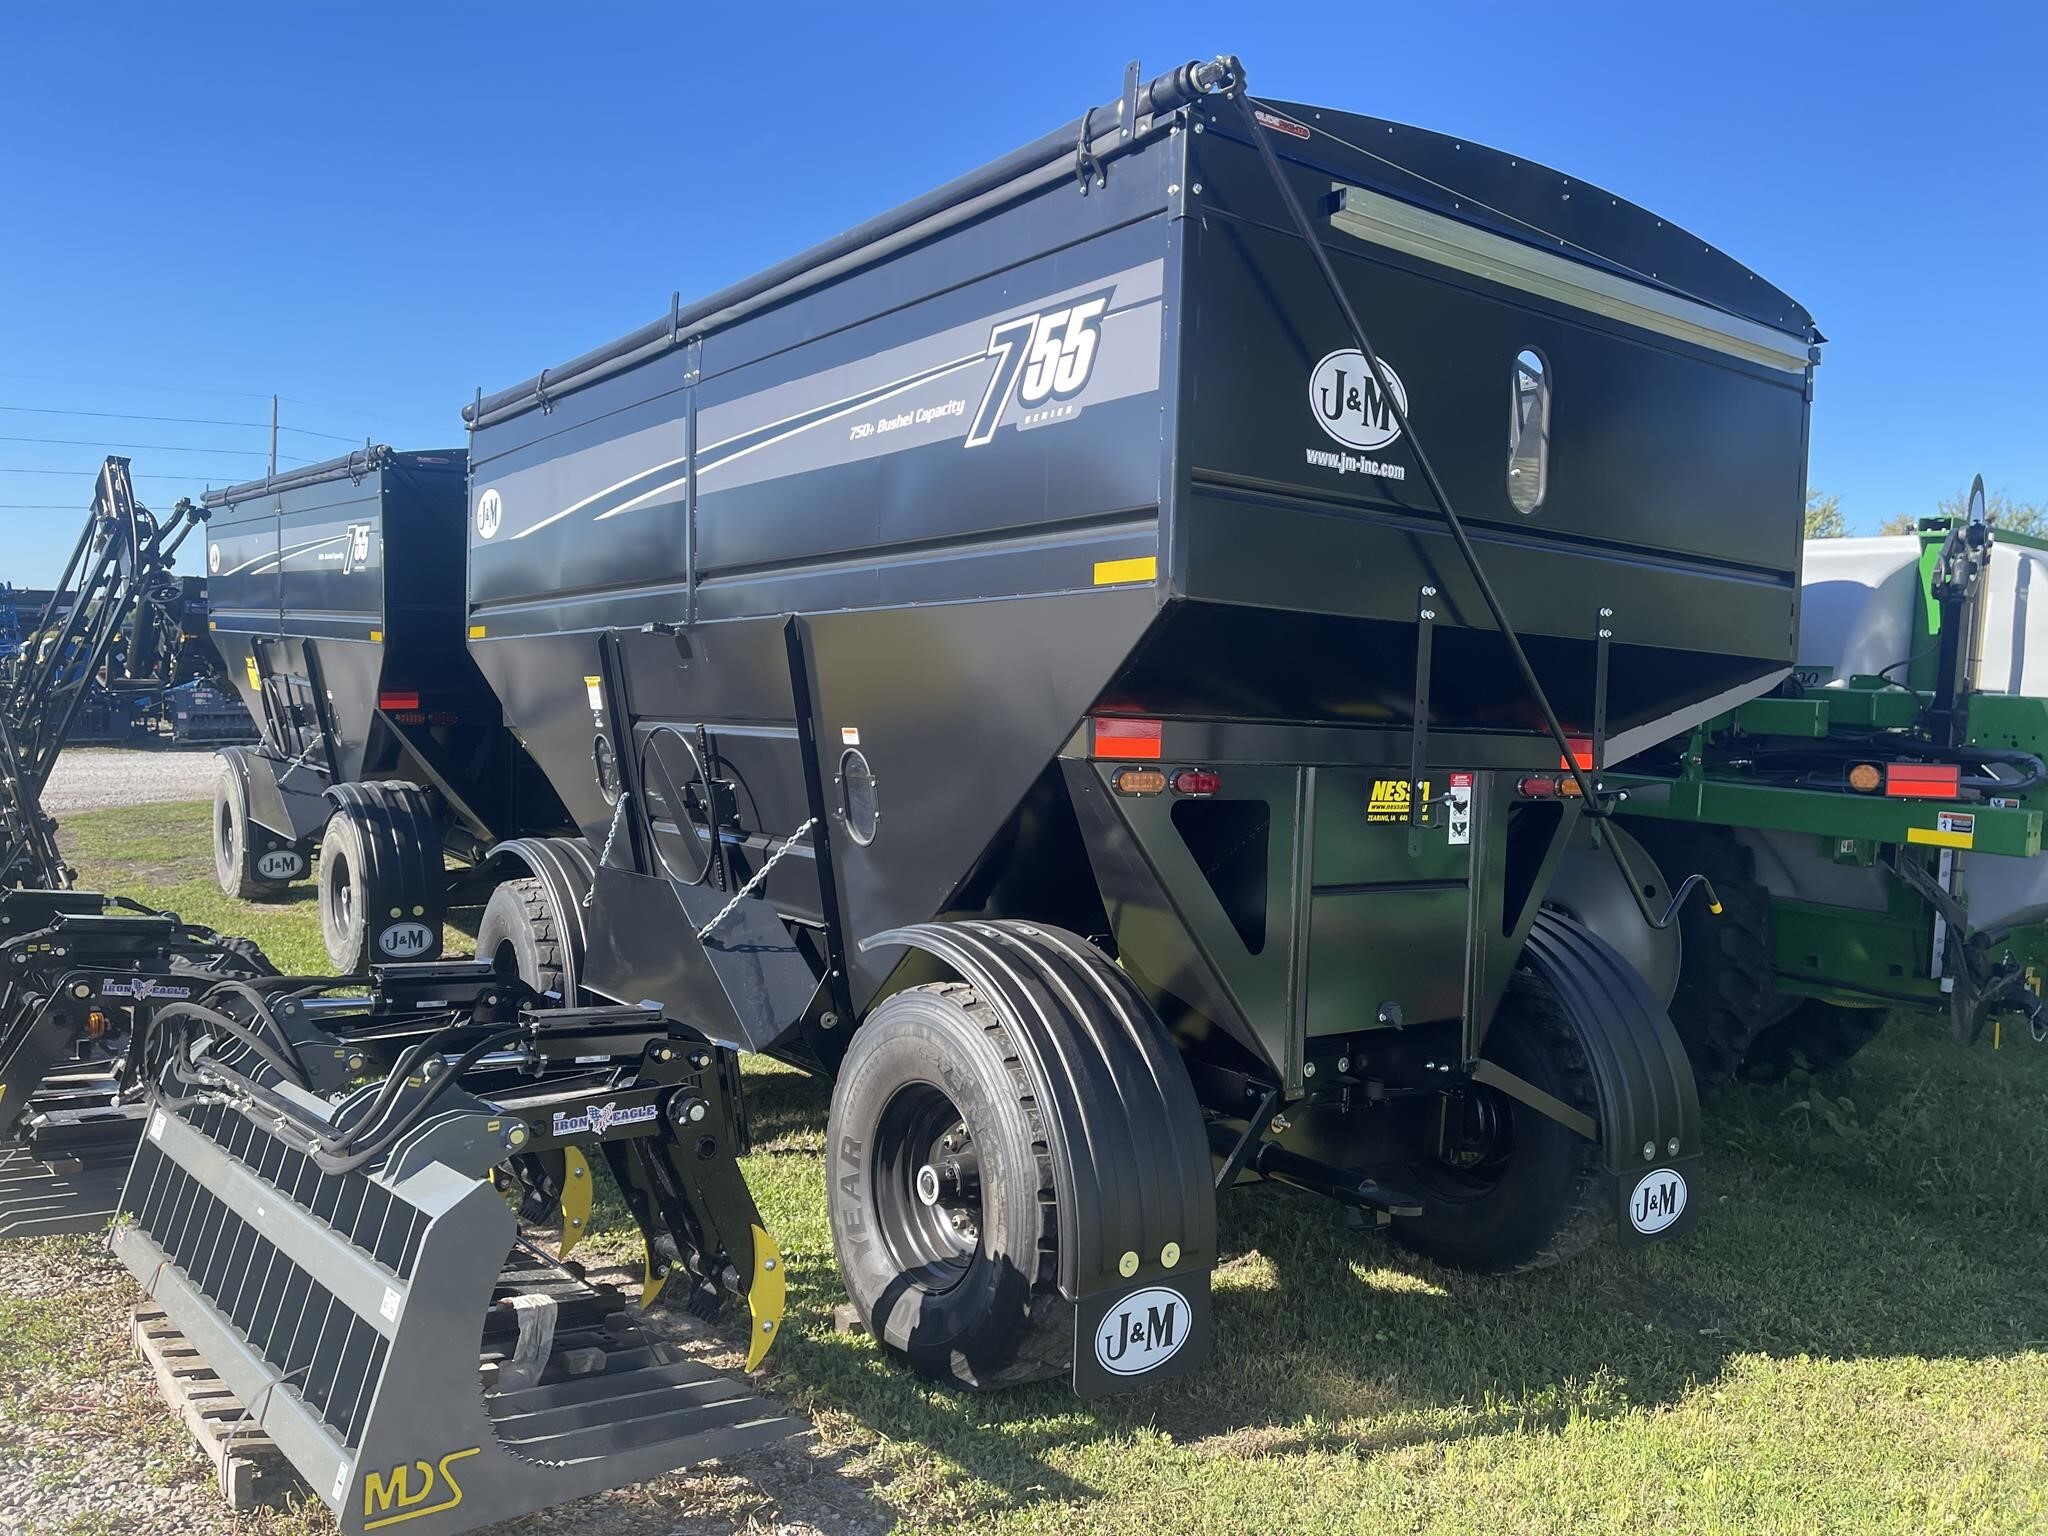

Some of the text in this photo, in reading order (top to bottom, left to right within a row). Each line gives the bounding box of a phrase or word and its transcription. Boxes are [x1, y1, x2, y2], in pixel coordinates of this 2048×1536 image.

[964, 297, 1106, 449] 755
[1320, 368, 1393, 432] J&M
[849, 399, 966, 441] 750+ Bushel Capacity
[1305, 448, 1405, 480] www.jm-inc.com
[479, 497, 498, 530] J&M
[263, 856, 295, 873] J&M
[385, 929, 424, 950] J&M
[103, 984, 189, 995] IRON EAGLE
[554, 1116, 588, 1132] IRON
[613, 1105, 655, 1121] EAGLE
[1636, 1181, 1678, 1222] J&M
[1104, 1302, 1177, 1361] J&M
[364, 1446, 481, 1531] MDS
